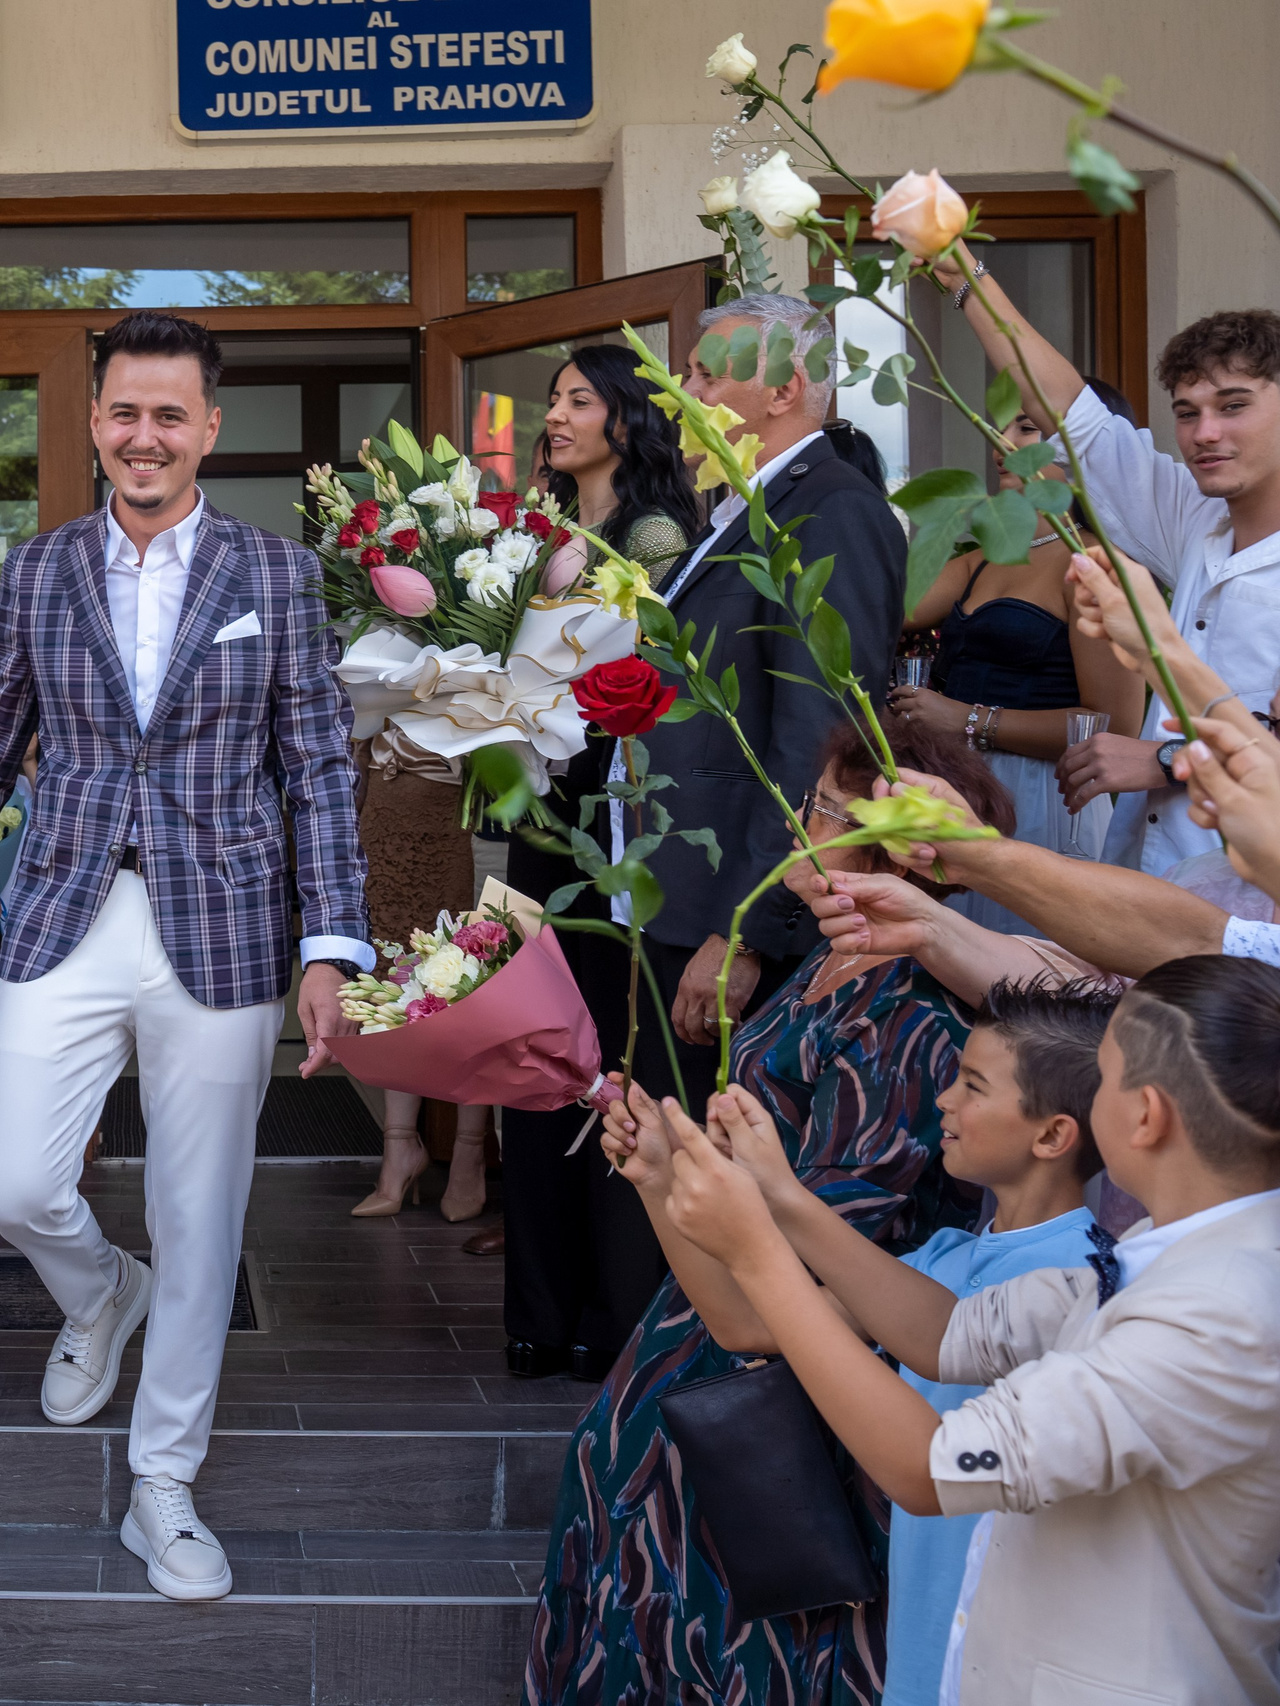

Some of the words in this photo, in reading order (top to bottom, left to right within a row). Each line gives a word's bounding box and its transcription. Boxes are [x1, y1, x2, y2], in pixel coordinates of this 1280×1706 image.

[367, 11, 399, 28] AL
[205, 36, 377, 76] COMUNEI
[389, 30, 565, 69] STEFESTI
[205, 88, 372, 118] JUDETUL
[393, 82, 566, 112] PRAHOVA
